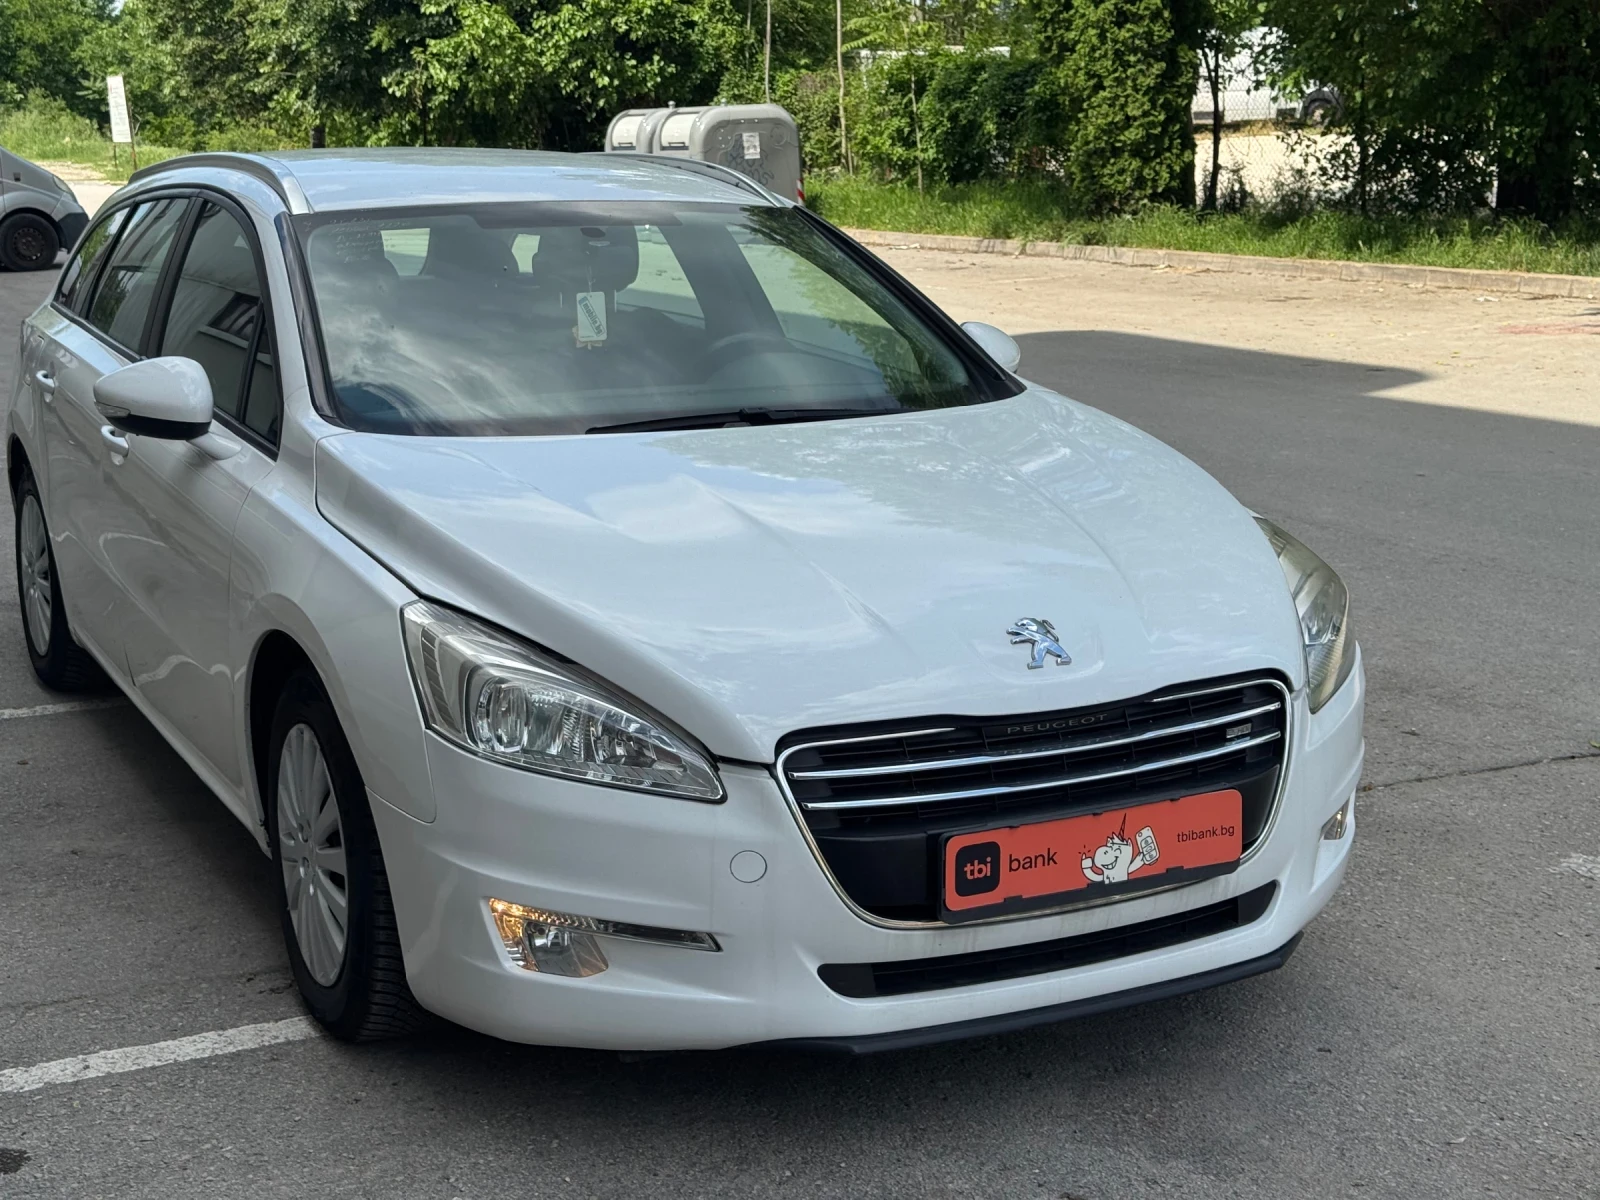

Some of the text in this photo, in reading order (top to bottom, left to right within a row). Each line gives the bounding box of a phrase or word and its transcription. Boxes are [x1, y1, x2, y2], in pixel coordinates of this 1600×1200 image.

[582, 302, 604, 335] mobile.bg
[1007, 714, 1107, 733] PEUGEOT
[1177, 825, 1235, 843] tbibank.bg
[963, 848, 1058, 880] tbi bank
